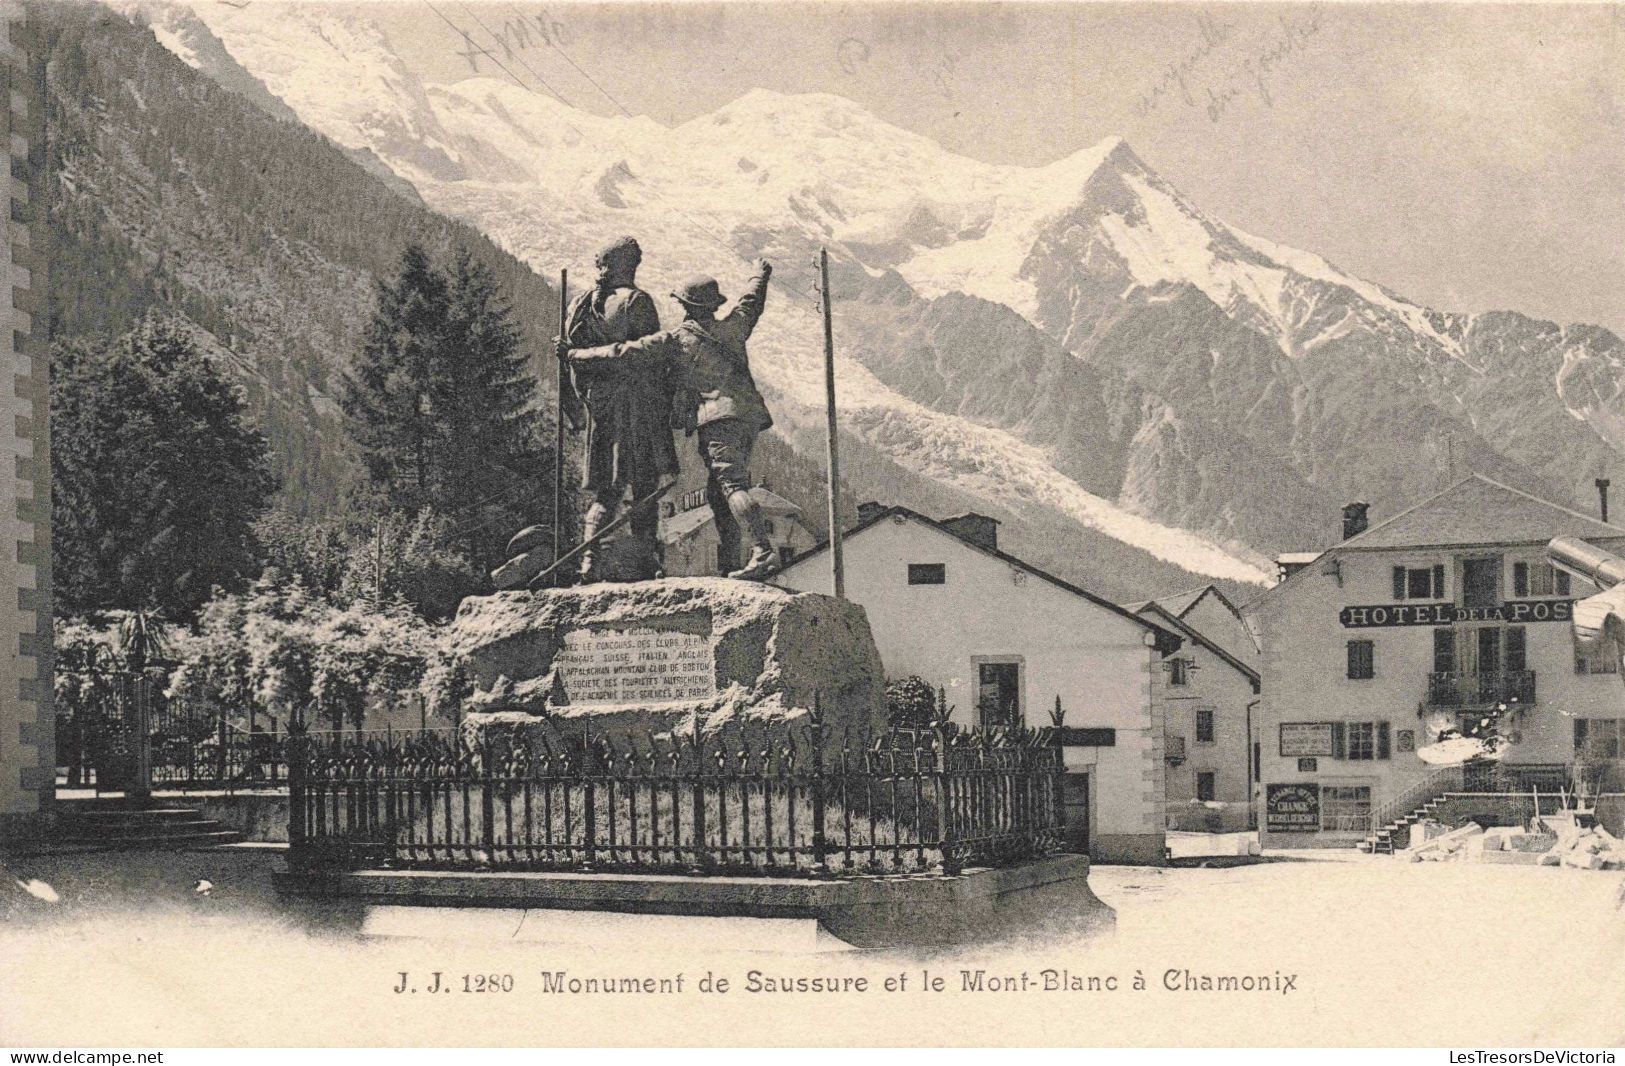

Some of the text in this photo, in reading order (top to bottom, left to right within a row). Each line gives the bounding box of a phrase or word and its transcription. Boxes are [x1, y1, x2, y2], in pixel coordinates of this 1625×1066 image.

[1348, 606, 1450, 625] HOTEL
[1511, 602, 1568, 621] POS
[597, 641, 632, 650] CONCOURS
[637, 639, 650, 648] DES
[656, 638, 679, 648] CLUBS
[604, 653, 629, 663] SUISSE
[639, 651, 668, 661] ITALIEN
[678, 650, 709, 659] ANGLAIS
[649, 664, 667, 673] CLUB
[670, 663, 679, 672] DE
[683, 662, 709, 672] BOSTON
[605, 678, 618, 687] DES
